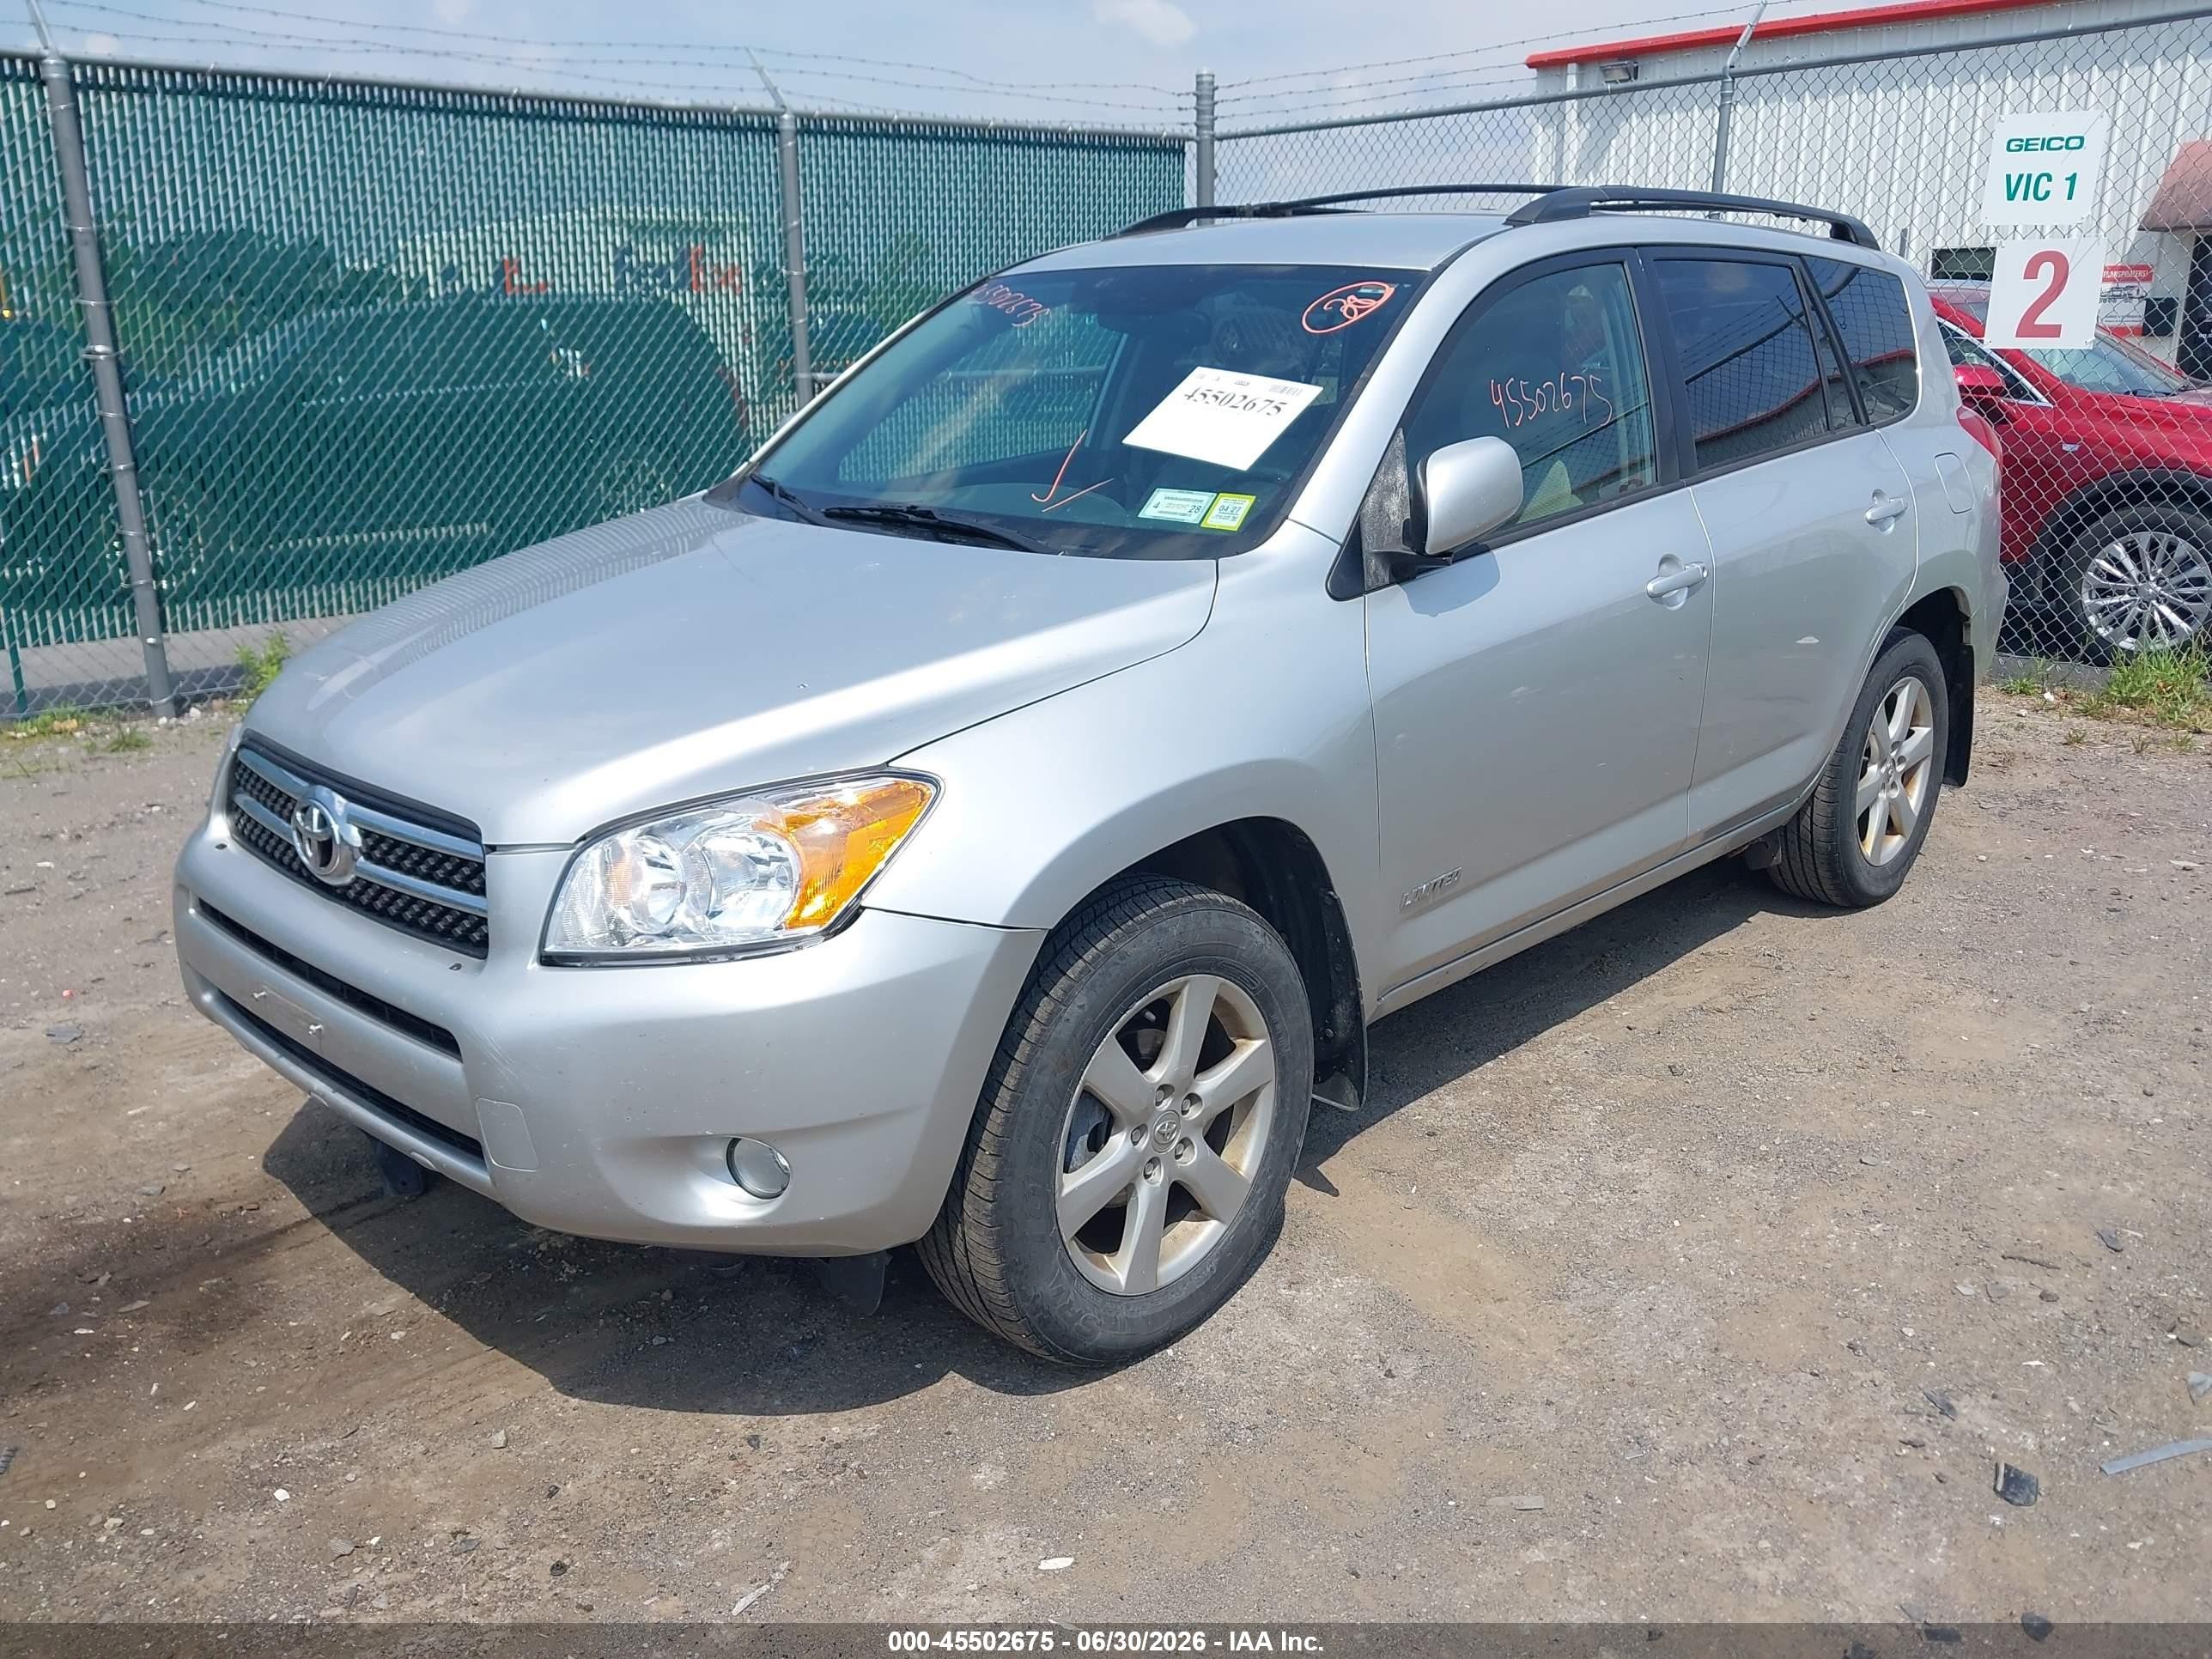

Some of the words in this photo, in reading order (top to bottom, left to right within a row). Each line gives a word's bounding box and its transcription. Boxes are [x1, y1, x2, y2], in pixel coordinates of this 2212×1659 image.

[2005, 136, 2085, 152] GEICO
[2005, 172, 2052, 202] VIC
[2064, 172, 2078, 201] 1
[2014, 250, 2069, 338] 2
[1184, 386, 1287, 416] 45502675
[1491, 372, 1613, 428] 45502675
